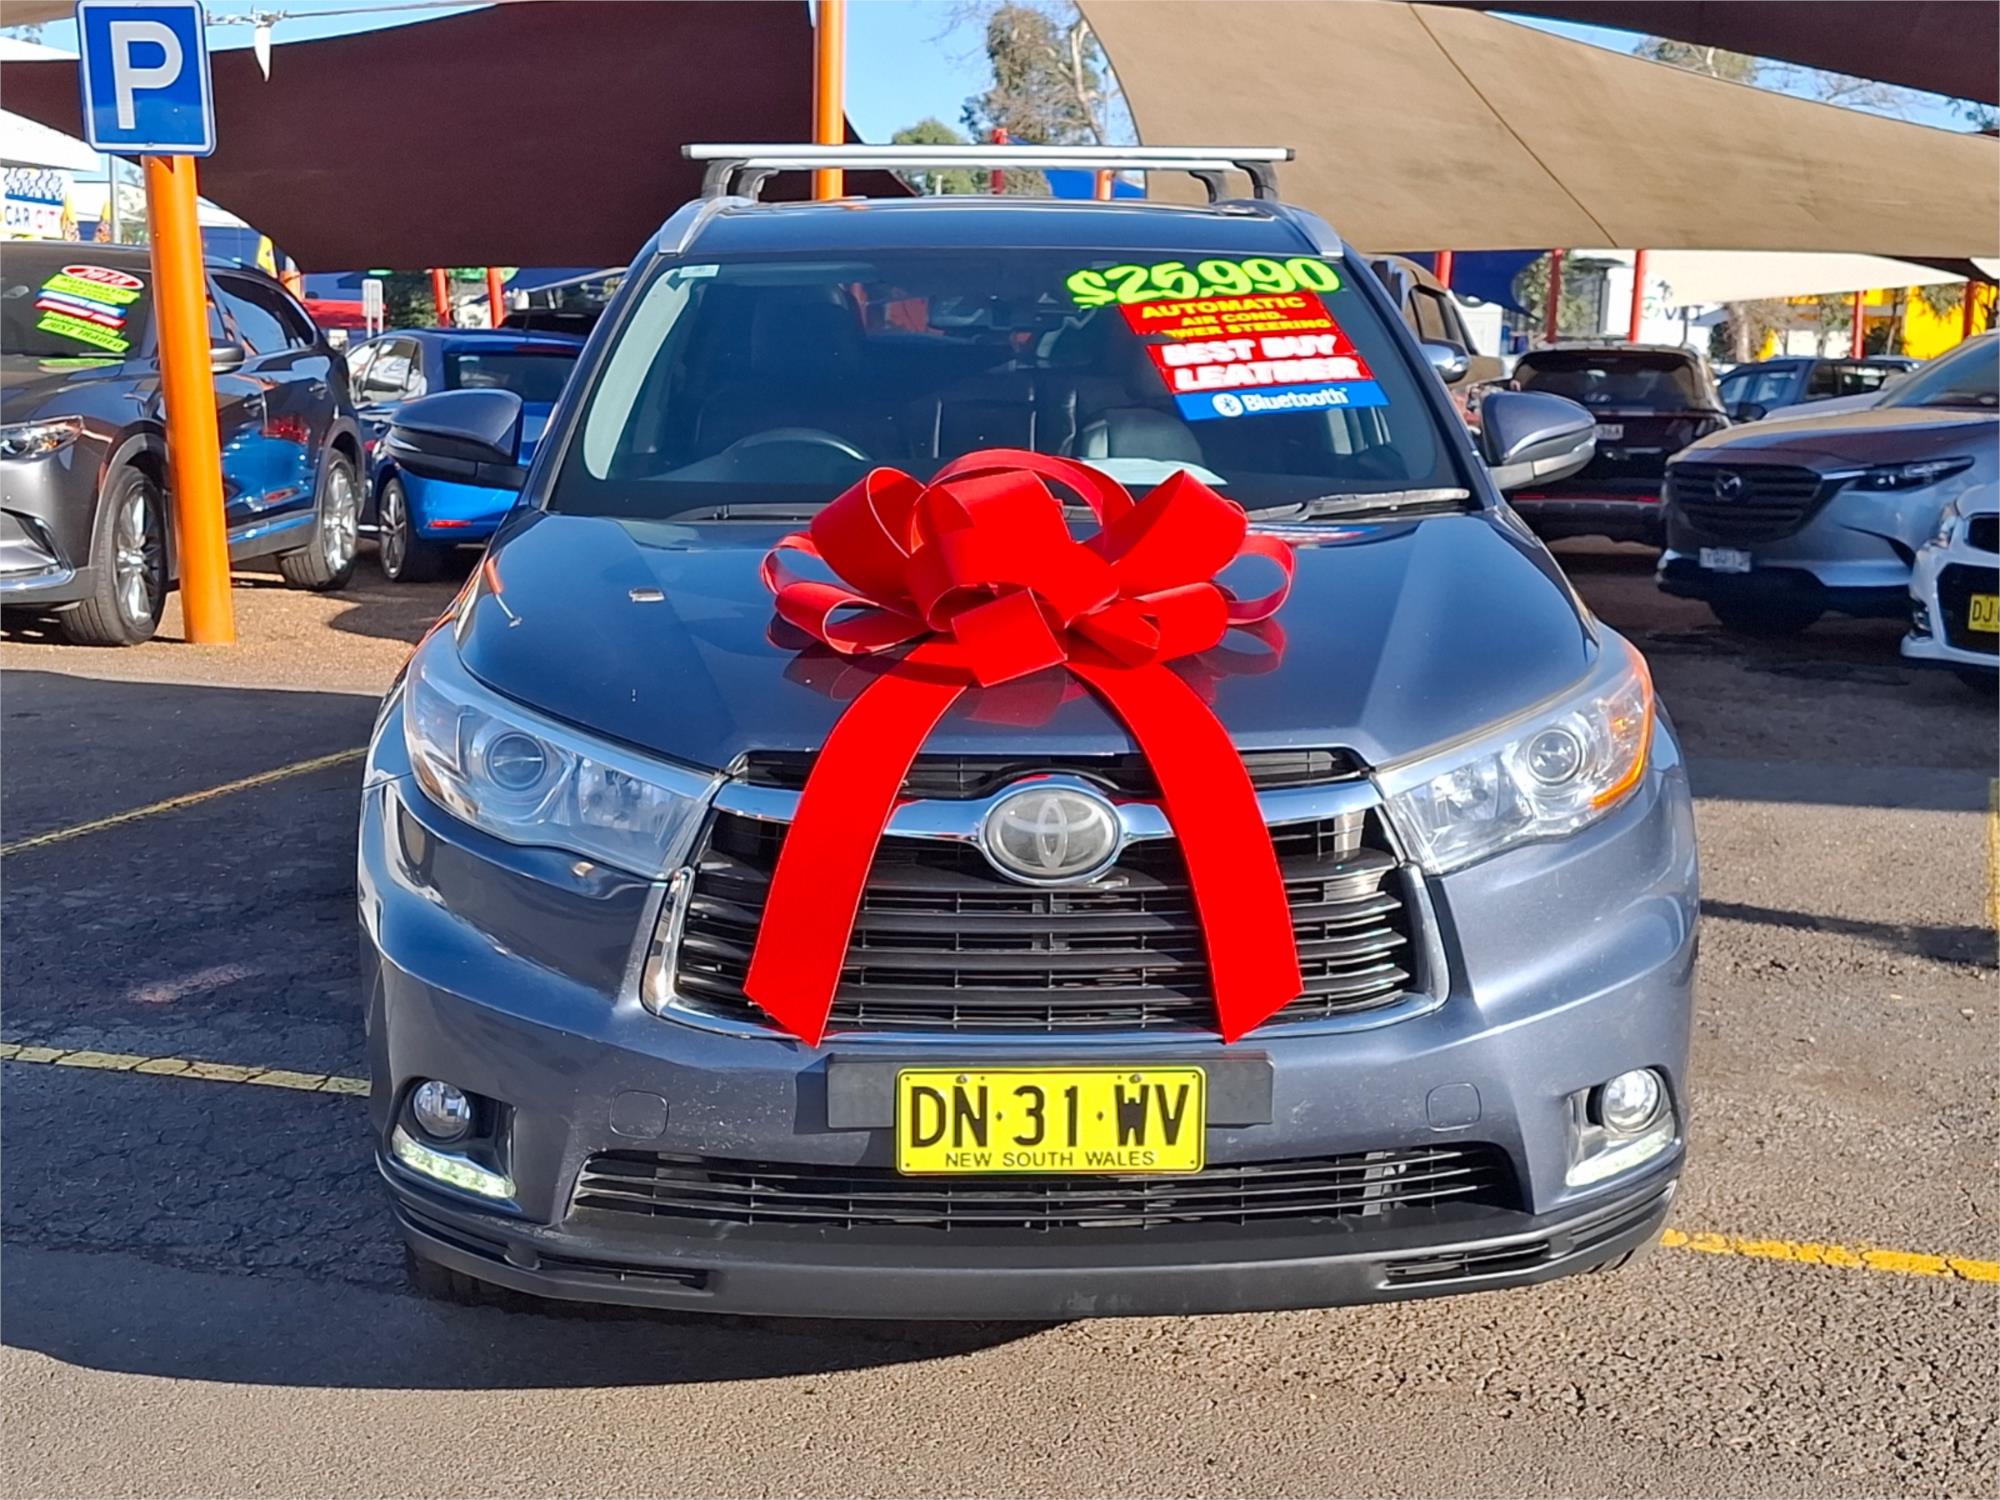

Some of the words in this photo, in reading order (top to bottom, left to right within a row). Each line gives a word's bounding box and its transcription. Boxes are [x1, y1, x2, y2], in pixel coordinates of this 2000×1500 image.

[109, 20, 184, 130] P
[1142, 296, 1307, 319] AUTOMATIC
[1181, 314, 1219, 327] AIR
[1221, 310, 1288, 323] COND.
[1225, 318, 1332, 334] STEERING
[1161, 338, 1257, 367] BEST
[1260, 333, 1338, 359] BUY
[1174, 356, 1362, 392] LEATHER
[1240, 388, 1350, 412] Bluetooth
[945, 1152, 992, 1168] NEW
[1002, 1151, 1074, 1168] SOUTH
[1087, 1150, 1155, 1167] WALES
